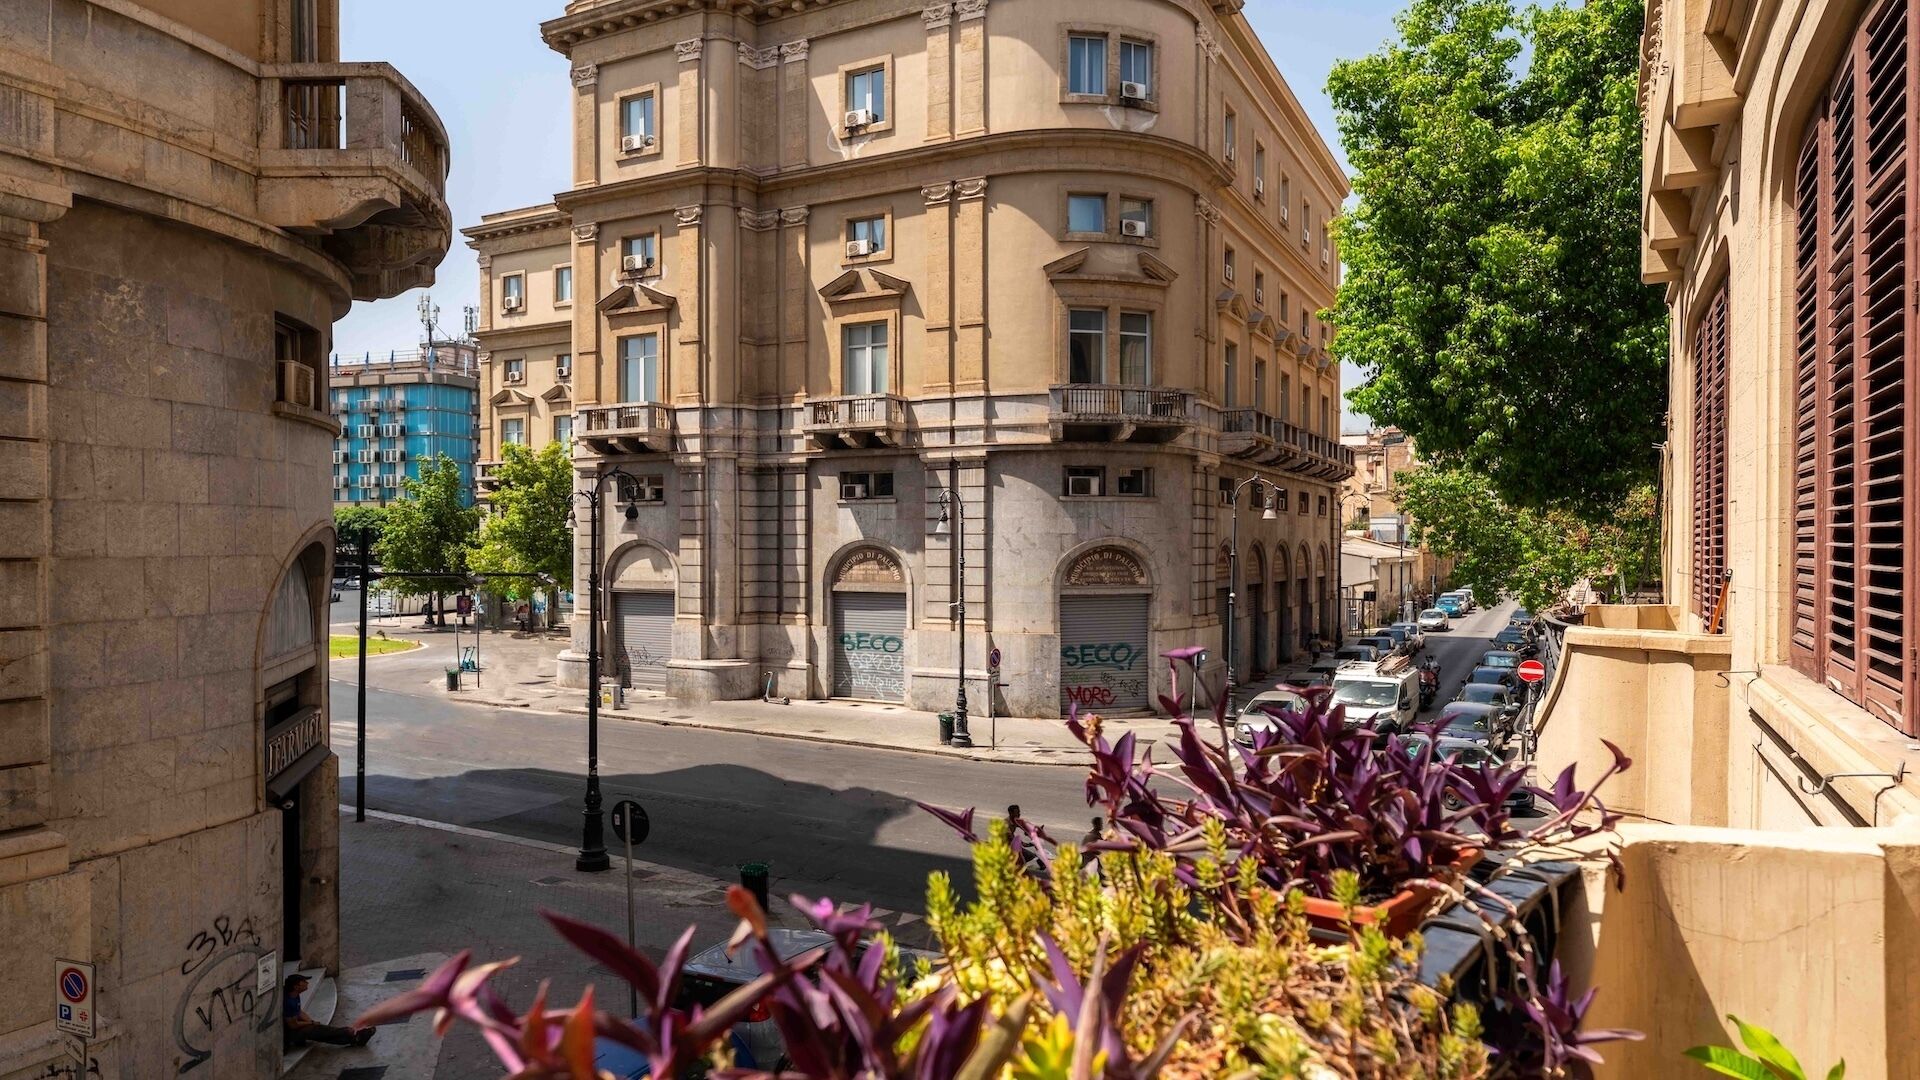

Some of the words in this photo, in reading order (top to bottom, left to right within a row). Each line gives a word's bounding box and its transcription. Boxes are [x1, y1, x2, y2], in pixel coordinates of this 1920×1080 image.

[839, 553, 864, 580] MUNICIPIO
[877, 553, 901, 580] PALERMO
[1070, 553, 1100, 584] MUNICIPIO
[1115, 554, 1143, 582] PALERMO
[839, 631, 903, 652] SECO
[61, 1005, 70, 1018] P
